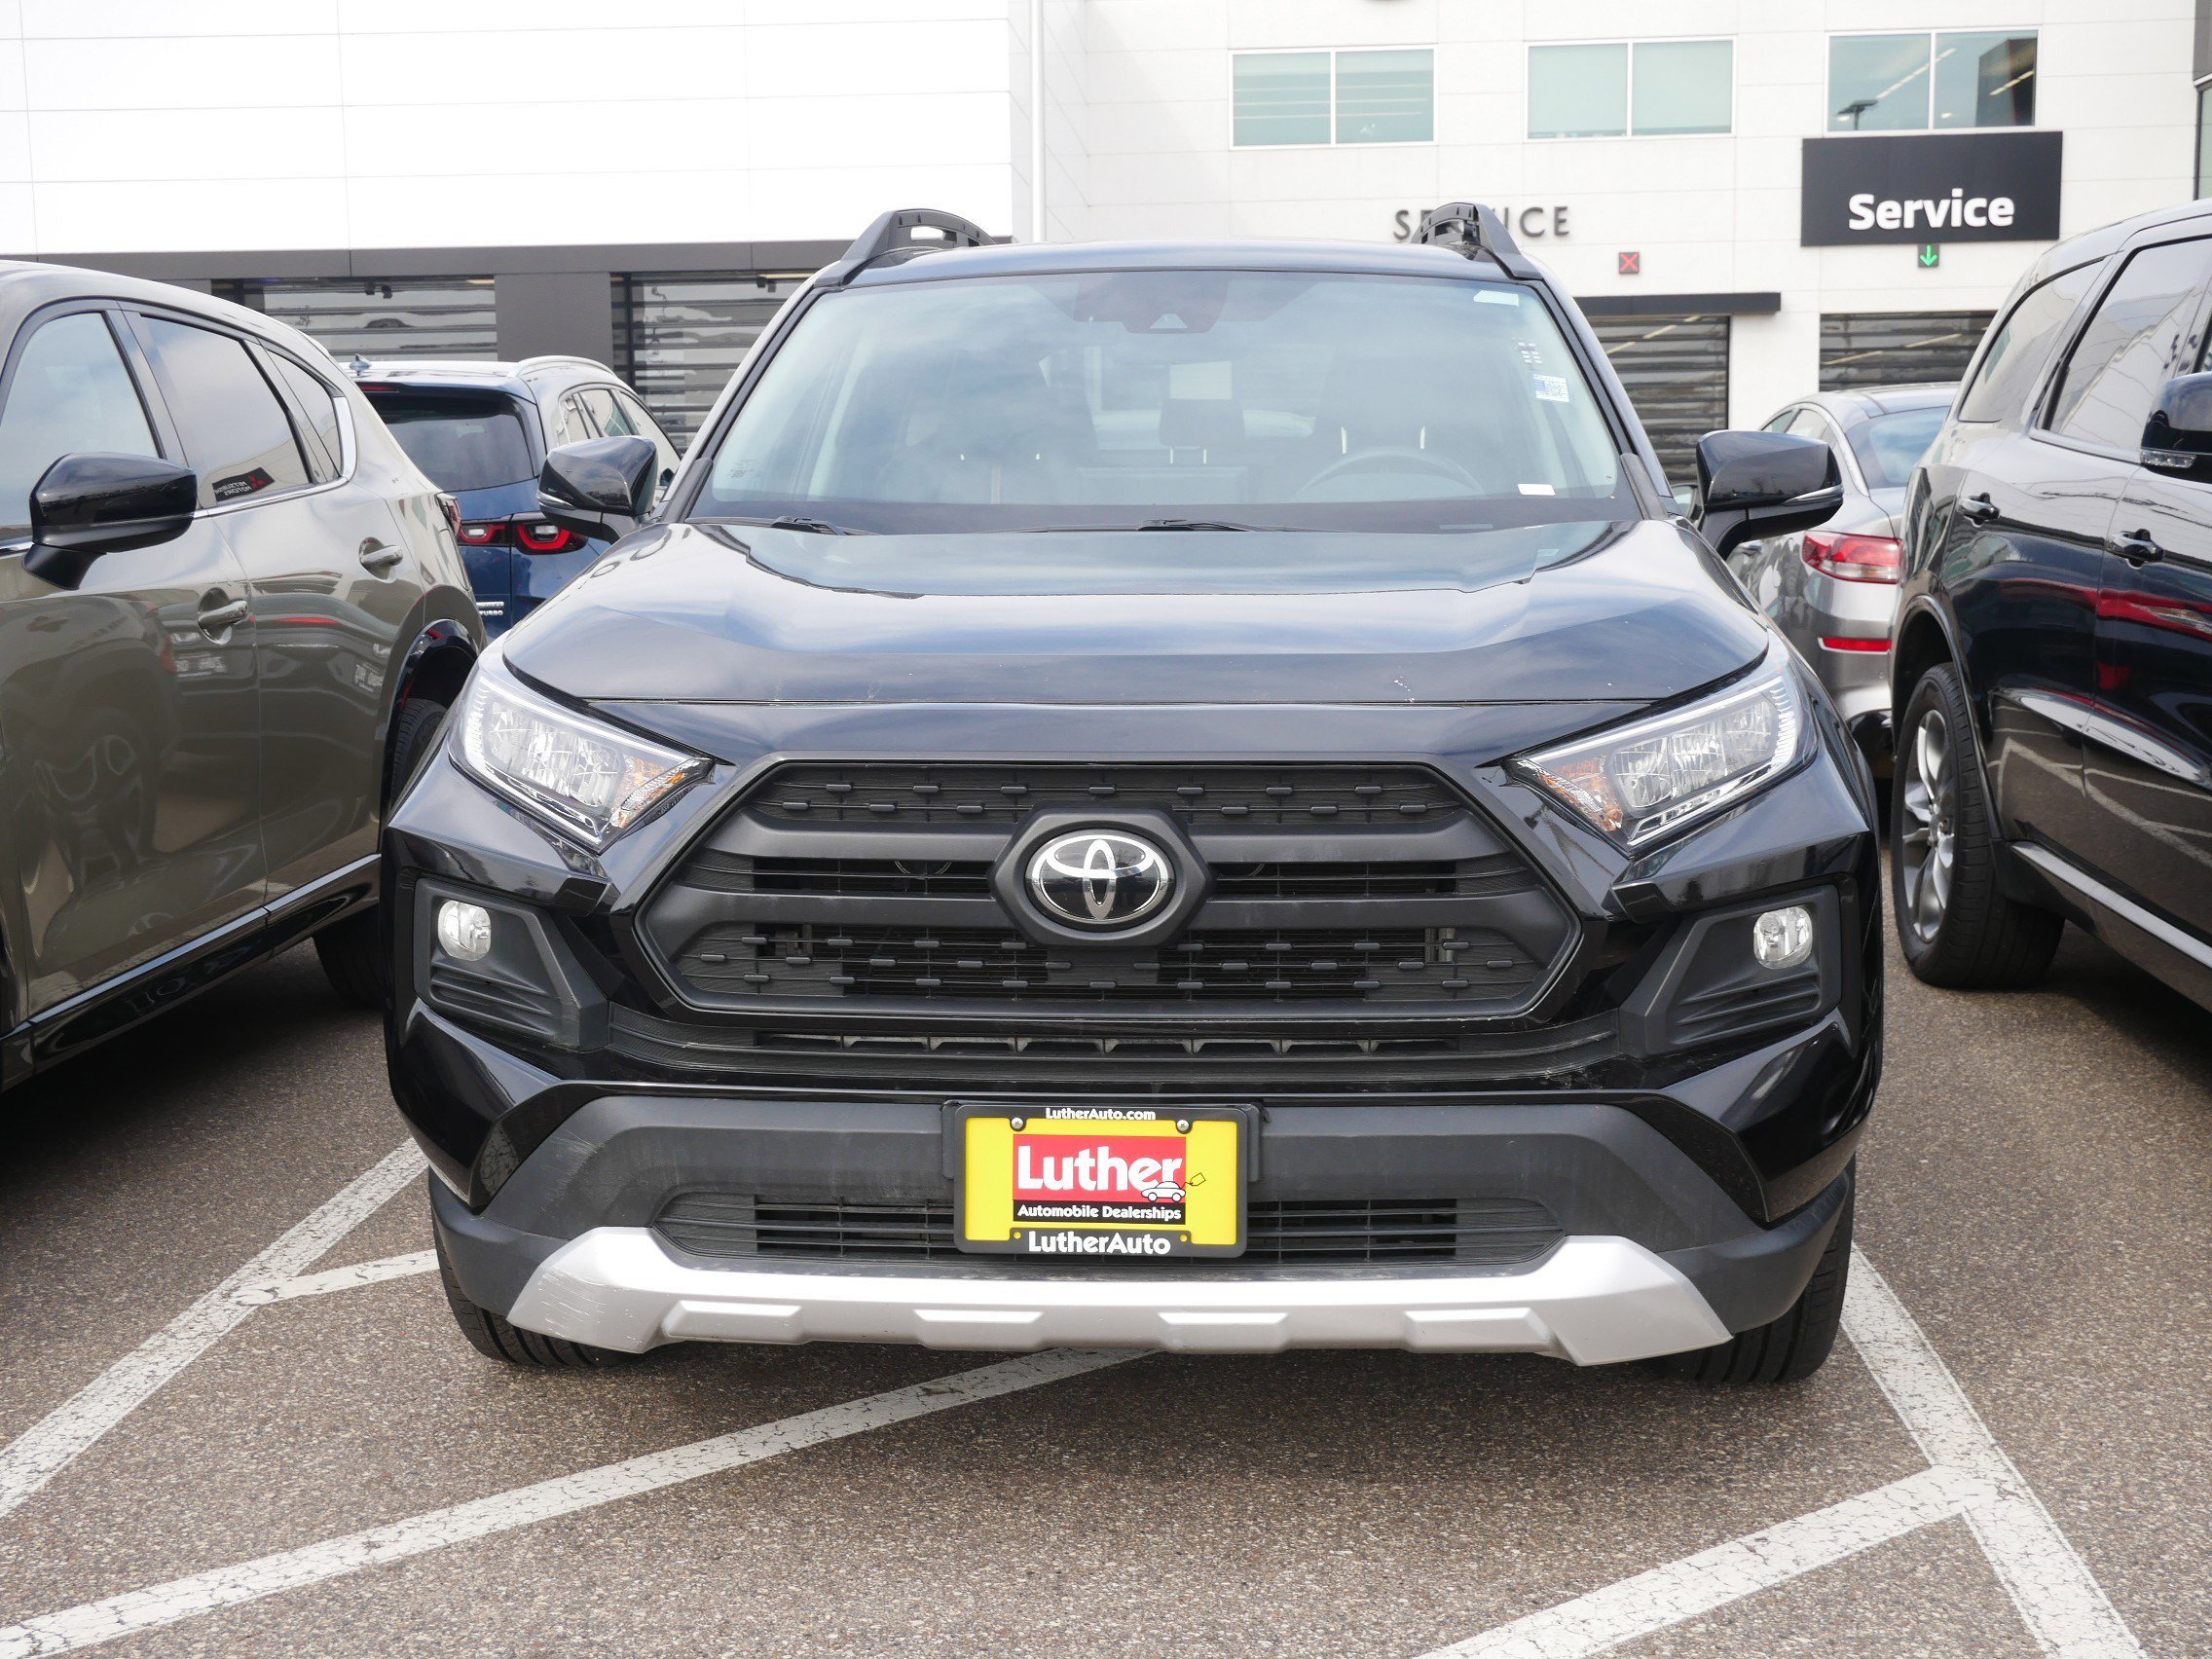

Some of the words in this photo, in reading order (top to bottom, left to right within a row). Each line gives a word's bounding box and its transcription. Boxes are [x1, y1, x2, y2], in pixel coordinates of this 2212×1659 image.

[1393, 206, 1569, 240] SICE
[1849, 188, 2015, 231] Service
[1046, 1107, 1157, 1121] LutherAuto.com
[1017, 1145, 1183, 1192] Luther
[1017, 1204, 1099, 1218] Automobile
[1102, 1206, 1182, 1221] Dealerships
[1028, 1231, 1171, 1255] LutherAuto
